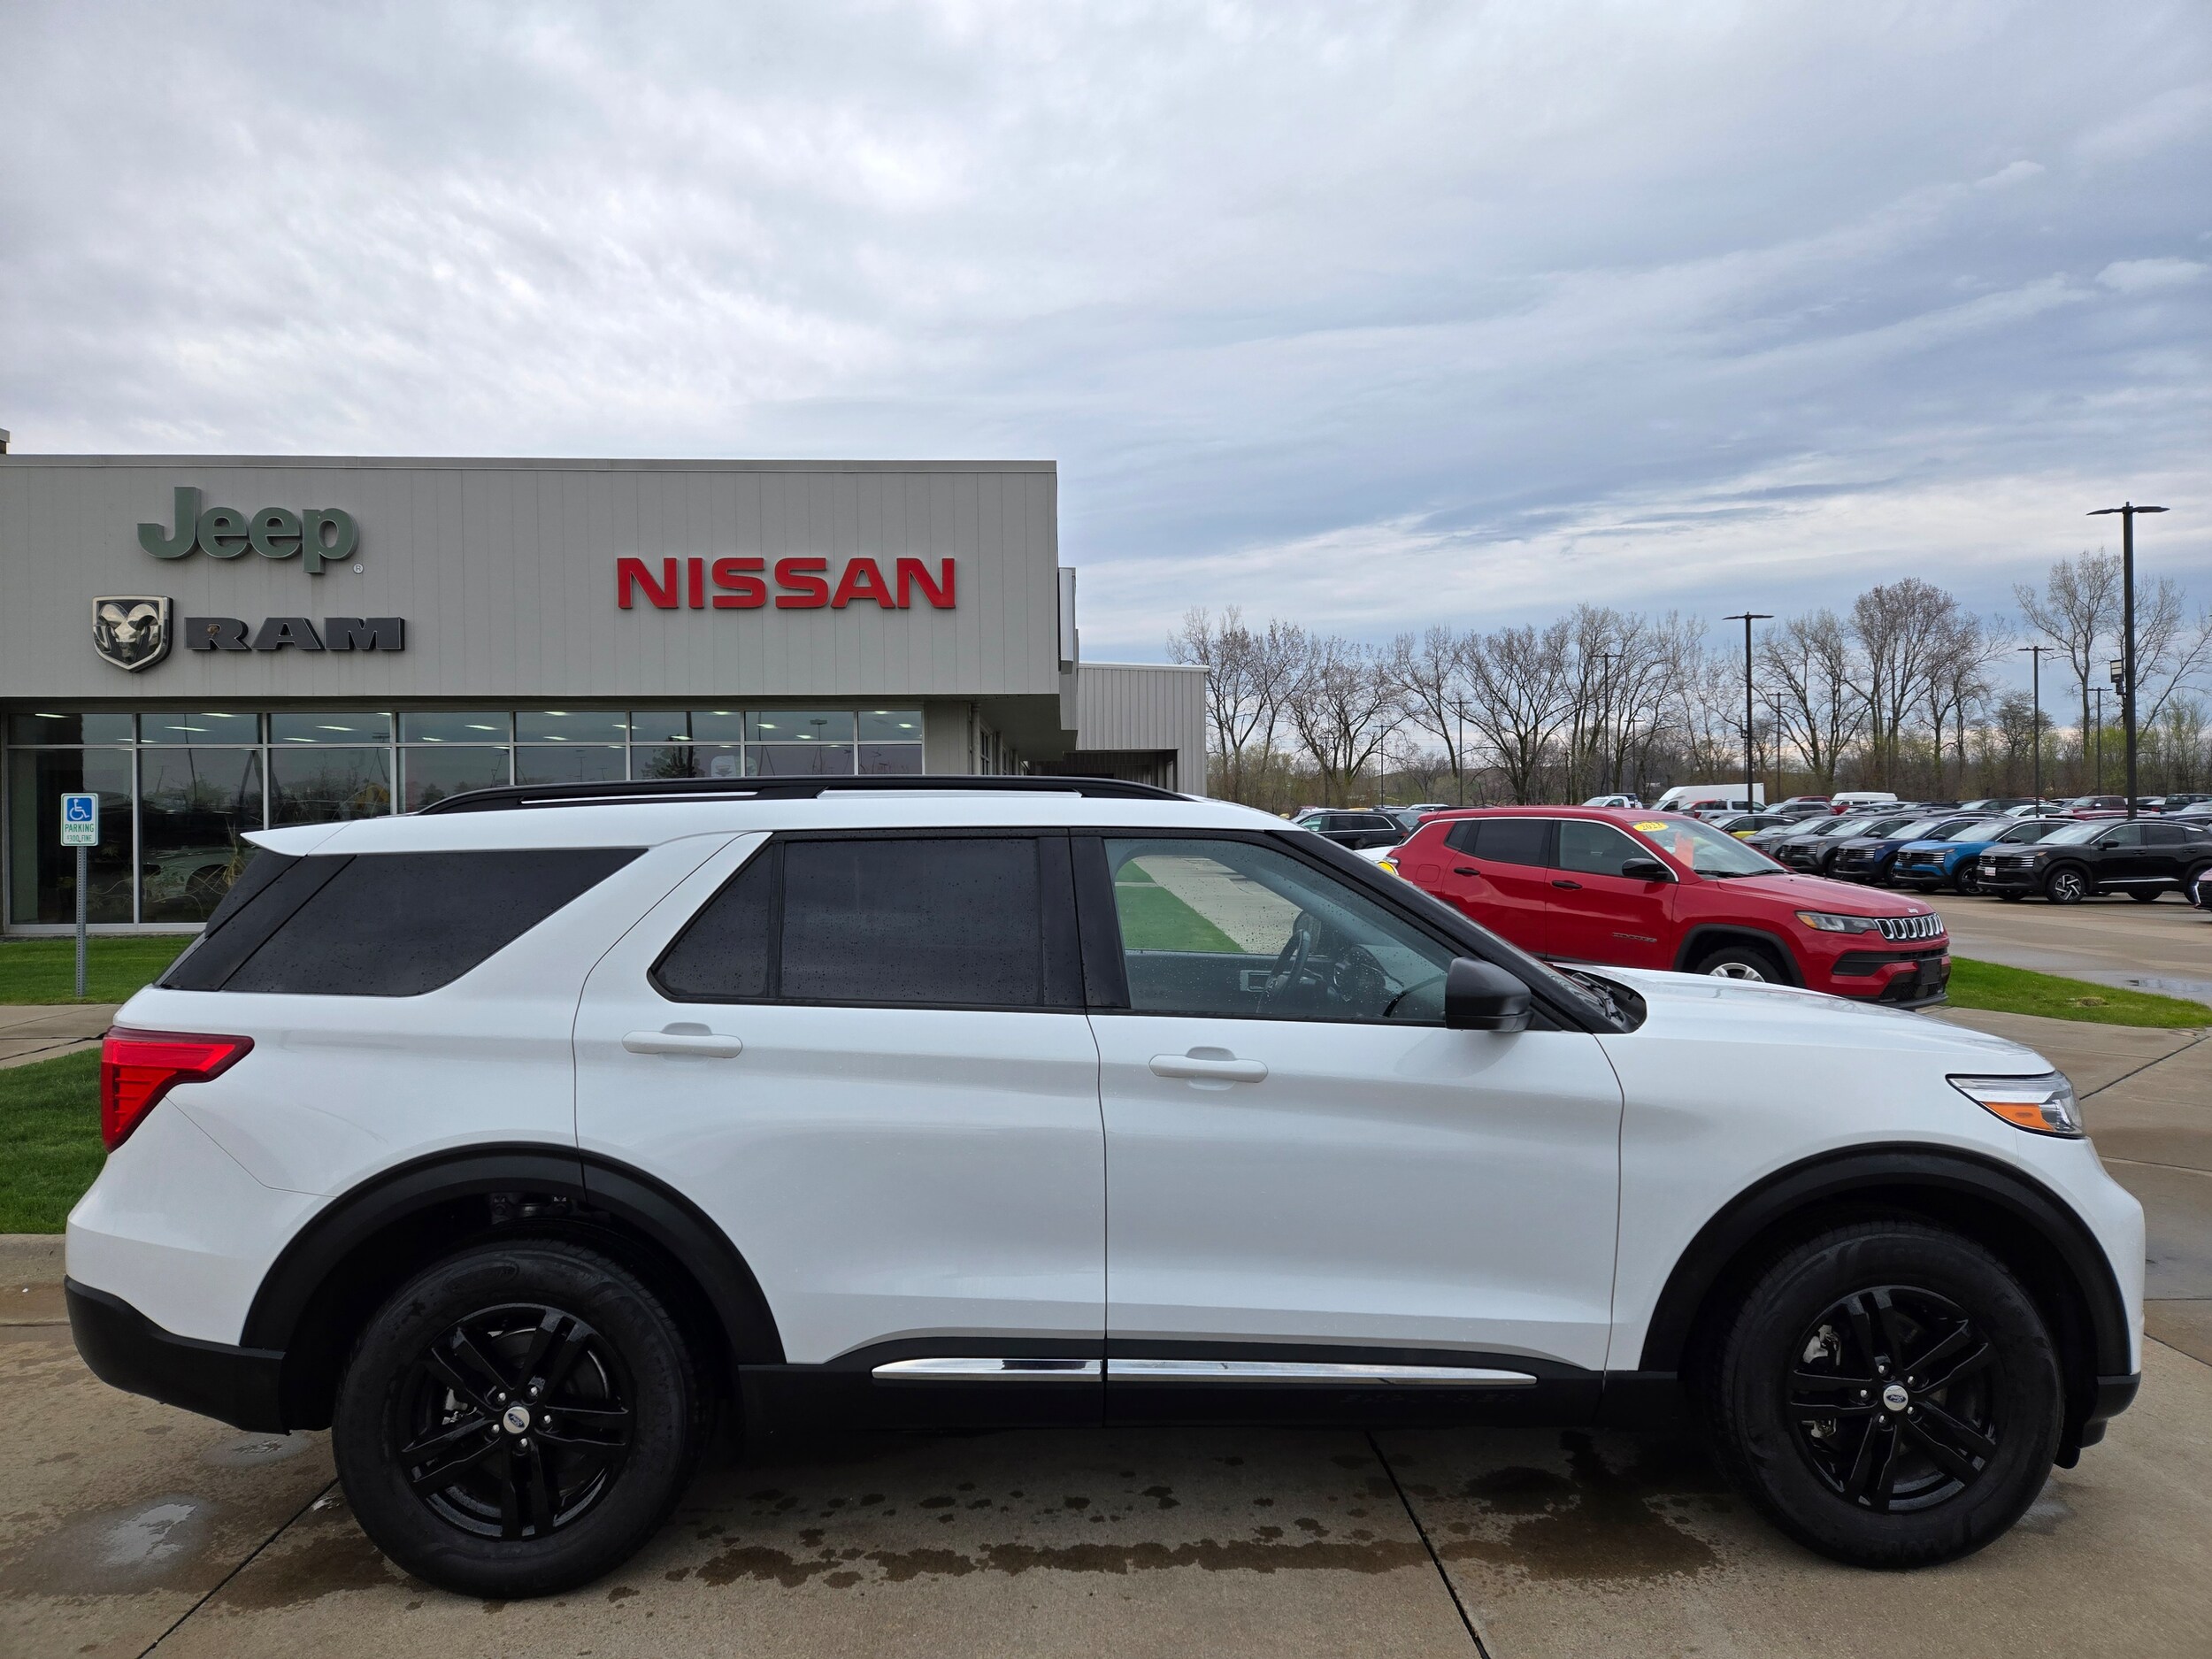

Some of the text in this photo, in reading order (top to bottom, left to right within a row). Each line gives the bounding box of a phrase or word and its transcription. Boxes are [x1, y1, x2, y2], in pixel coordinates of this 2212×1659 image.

[137, 487, 359, 575] Jeep
[617, 557, 956, 610] NISSAN
[184, 617, 405, 651] RAM
[65, 824, 95, 833] PARKING
